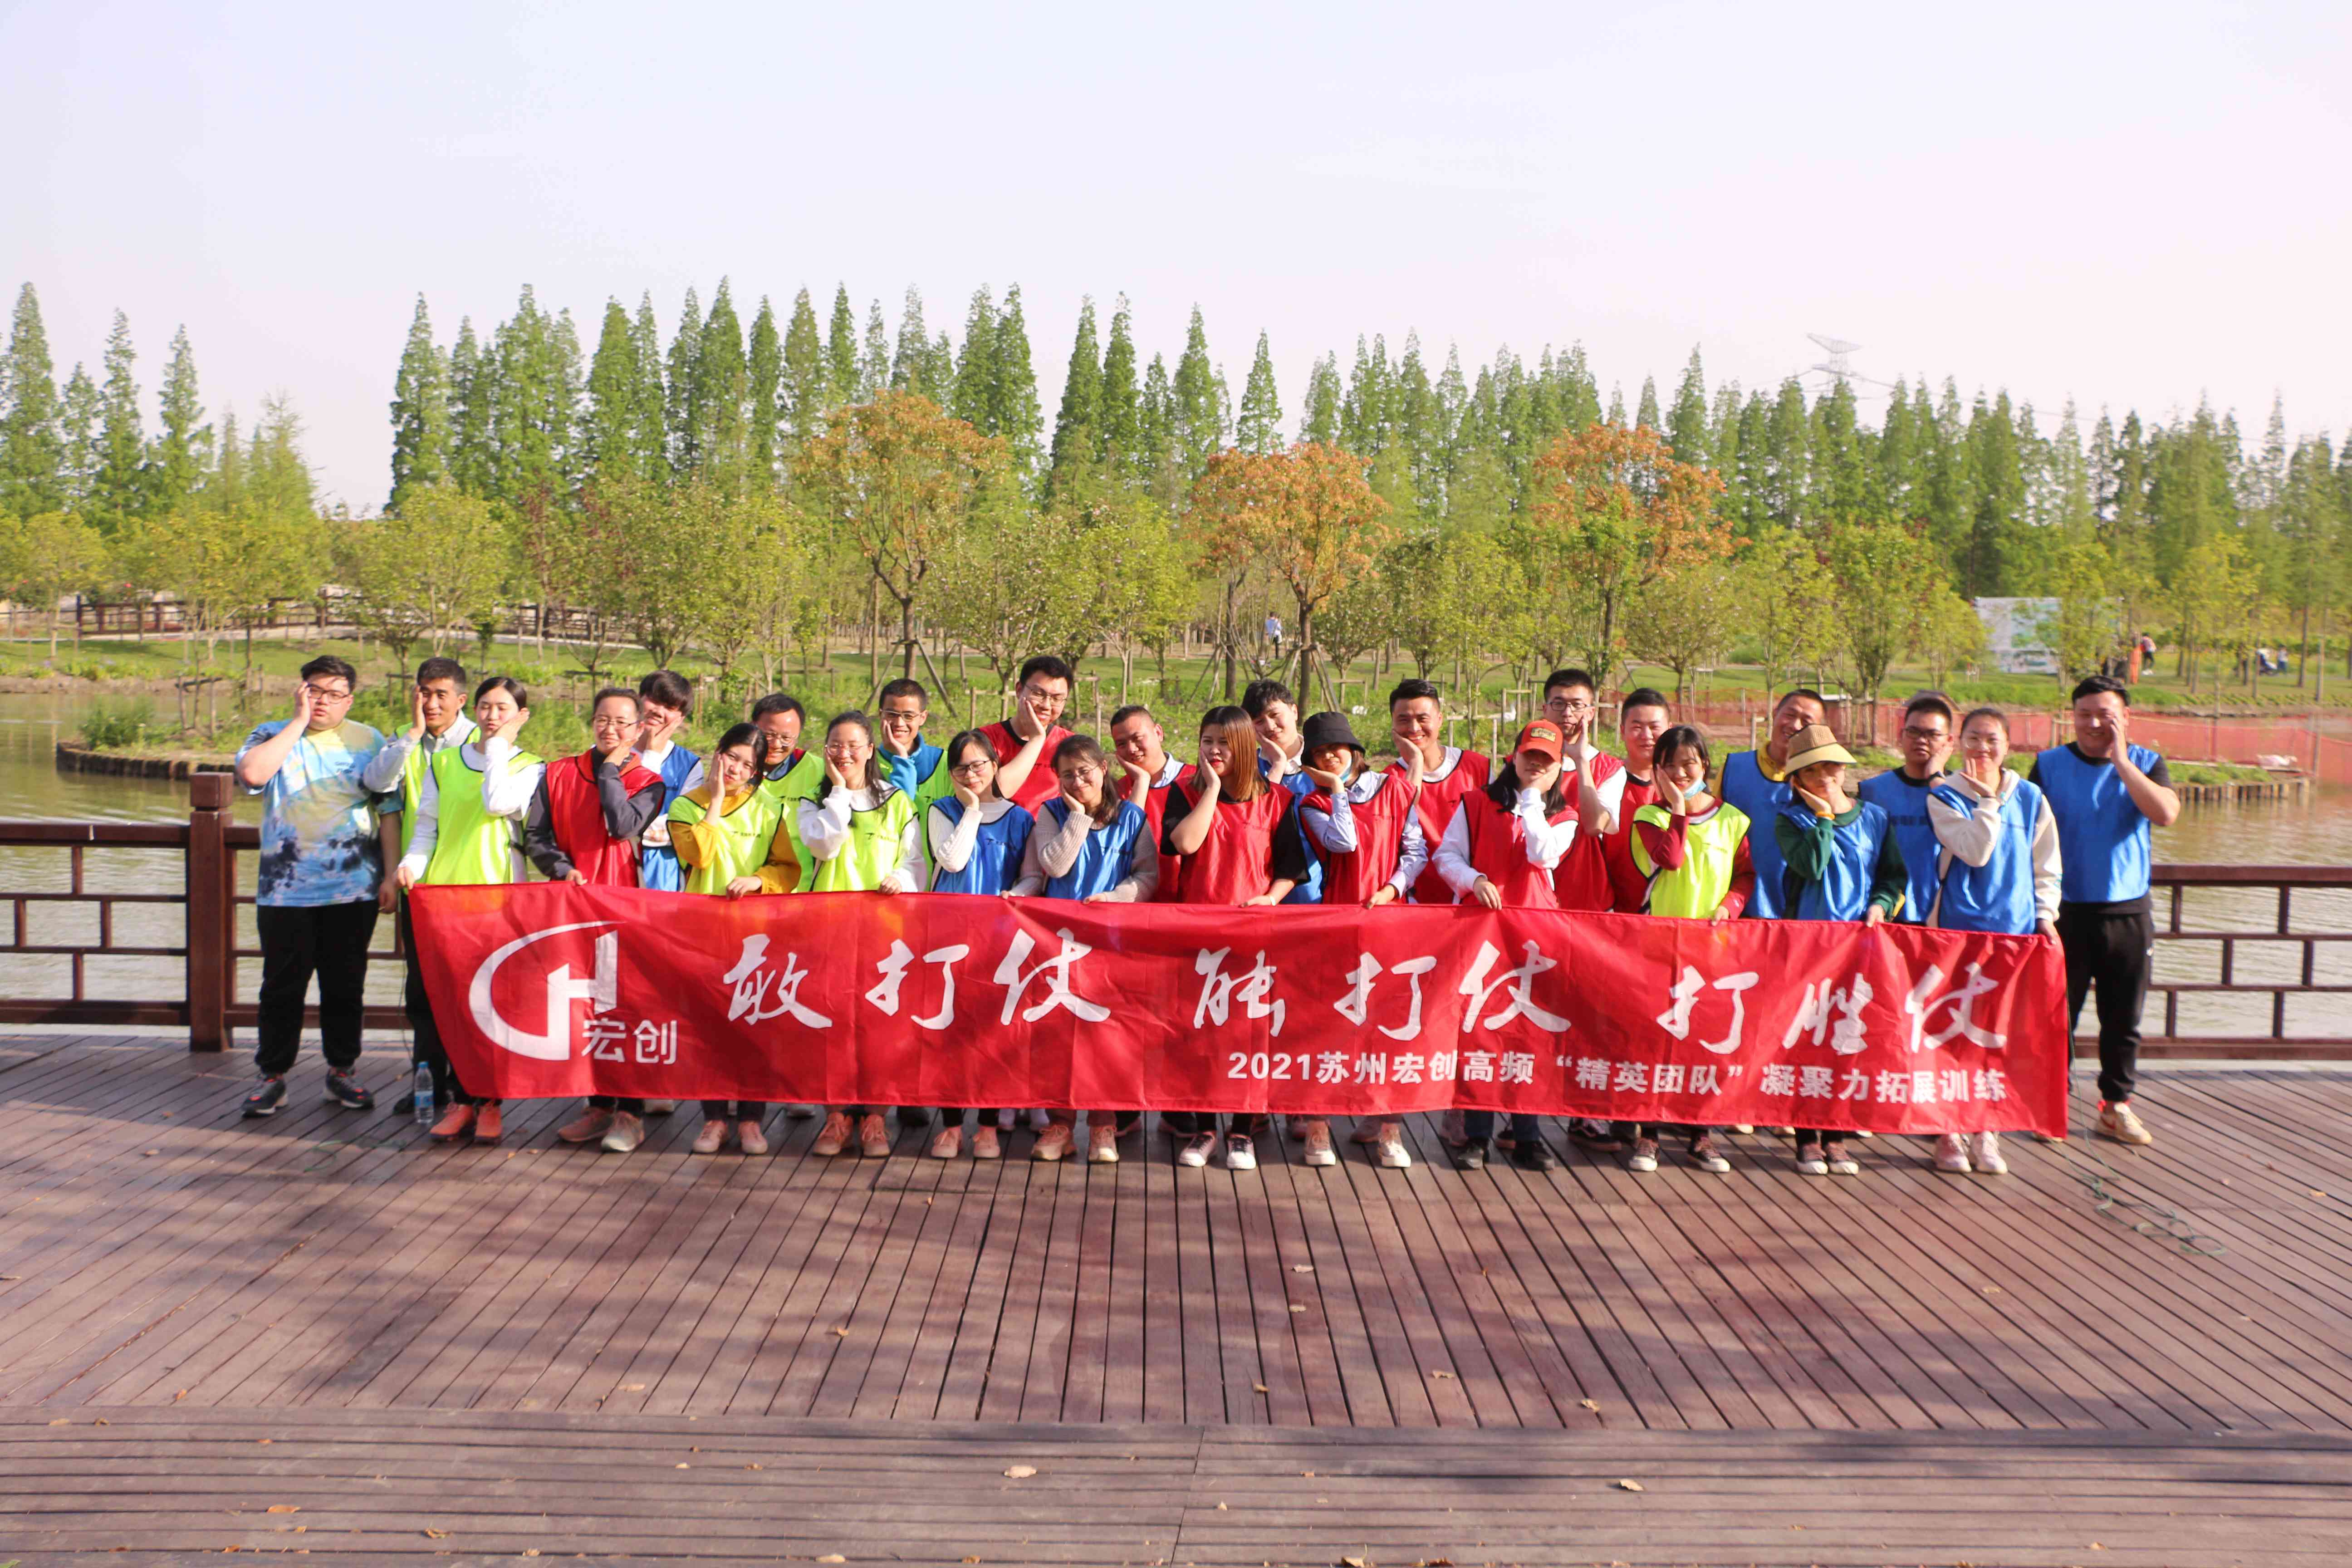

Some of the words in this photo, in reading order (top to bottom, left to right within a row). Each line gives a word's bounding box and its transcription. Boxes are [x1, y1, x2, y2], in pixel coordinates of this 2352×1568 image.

[723, 929, 1111, 1030] 敢打仗
[1193, 939, 1572, 1041] 能打仗
[1656, 962, 2007, 1055] 打胜仗
[582, 1018, 677, 1064] 宏创
